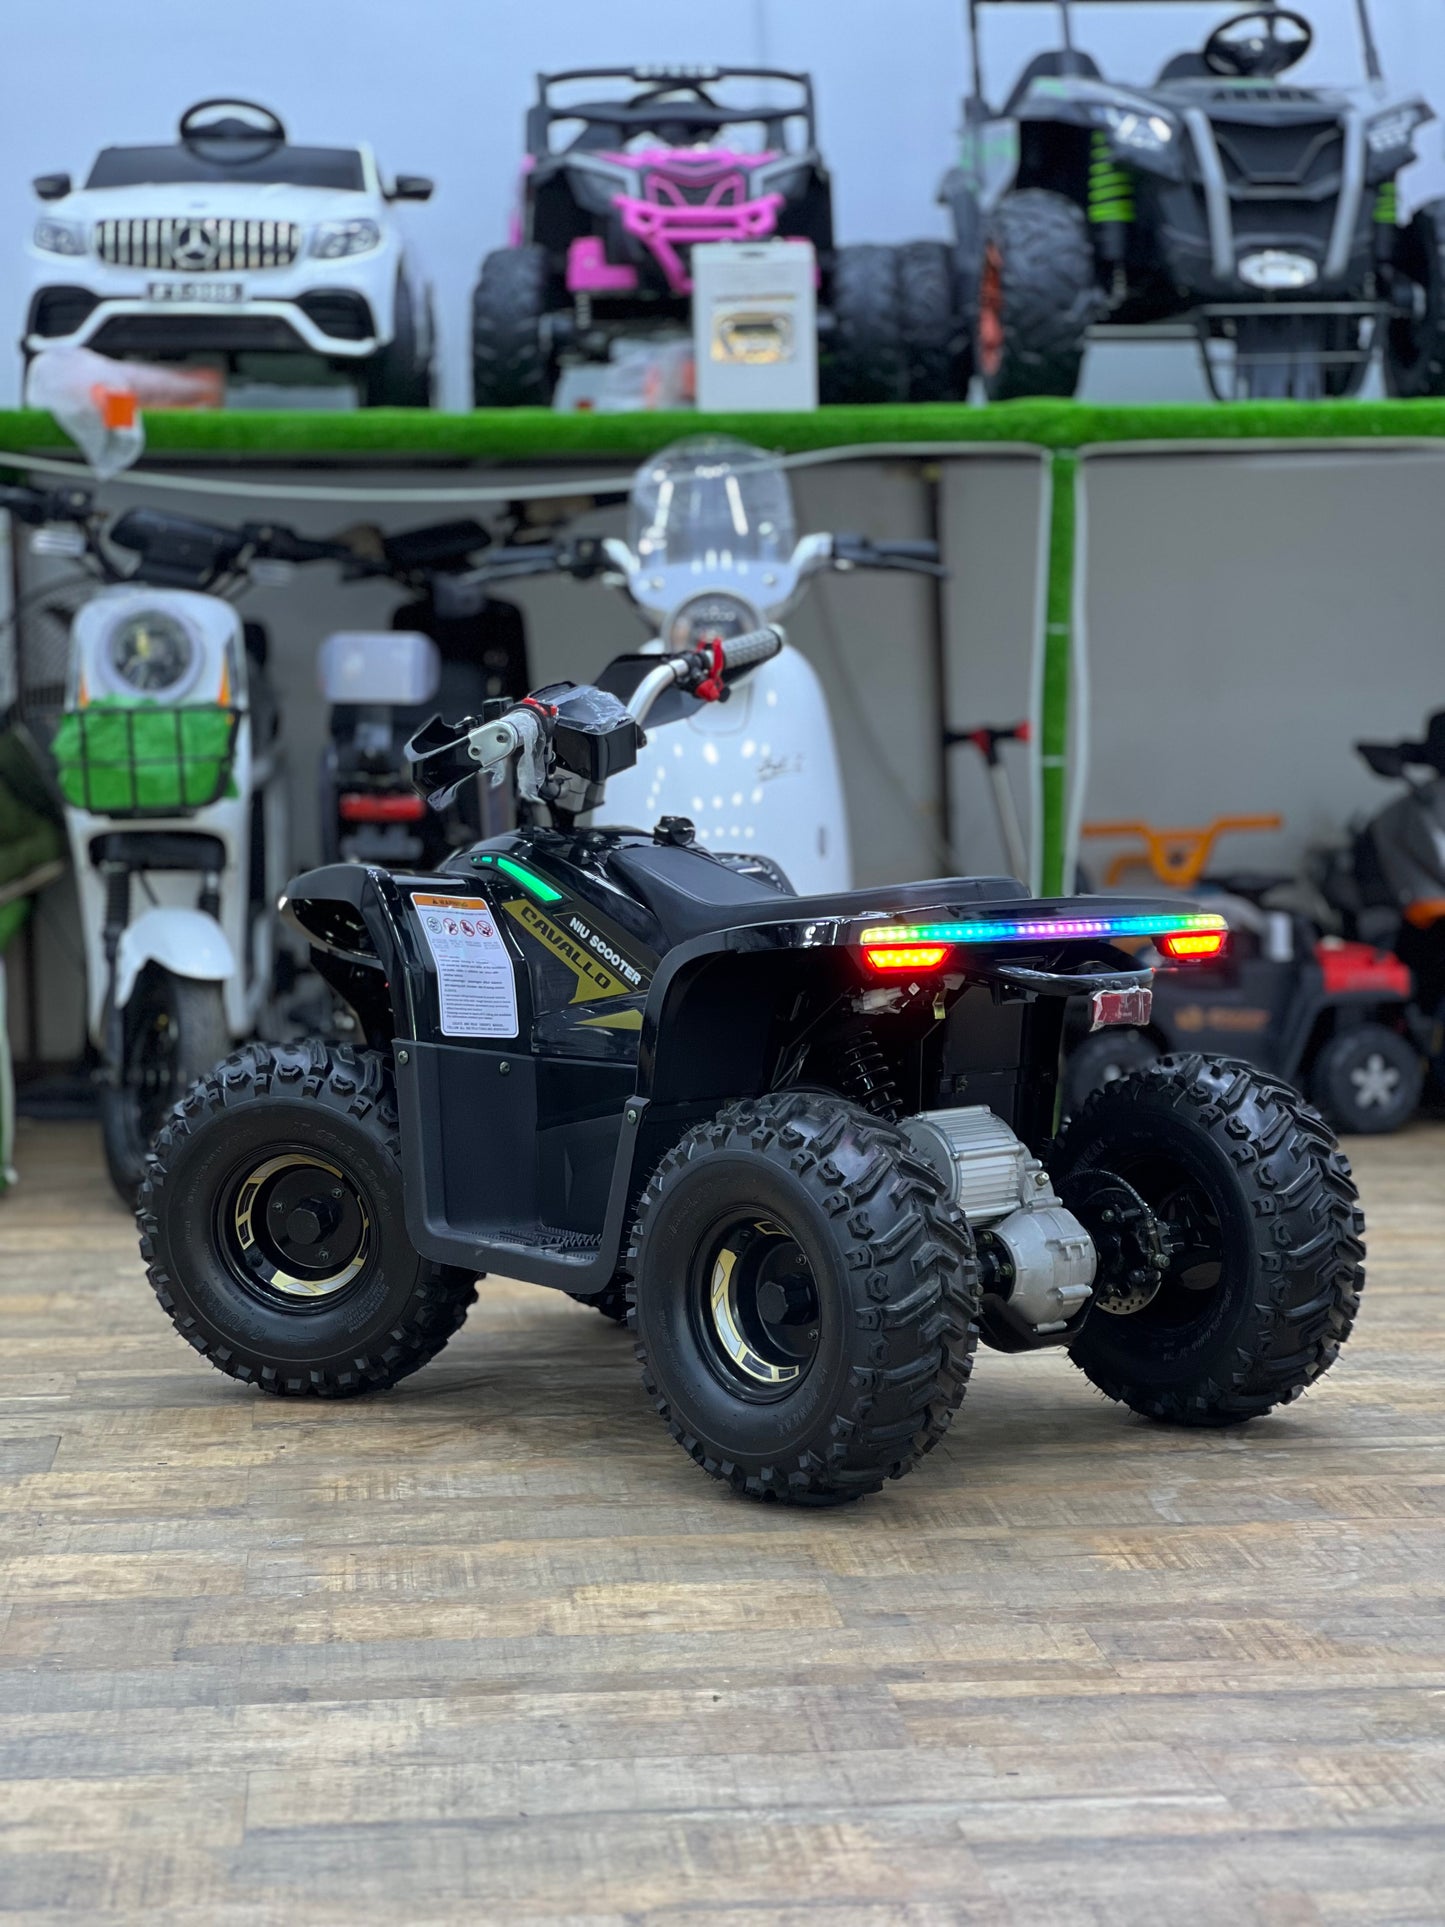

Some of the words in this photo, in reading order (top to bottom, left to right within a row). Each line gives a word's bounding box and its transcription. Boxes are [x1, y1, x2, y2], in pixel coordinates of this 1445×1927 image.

[521, 906, 611, 989] CAVALLO
[569, 916, 590, 939] NIU
[589, 935, 642, 985] SCOOTER
